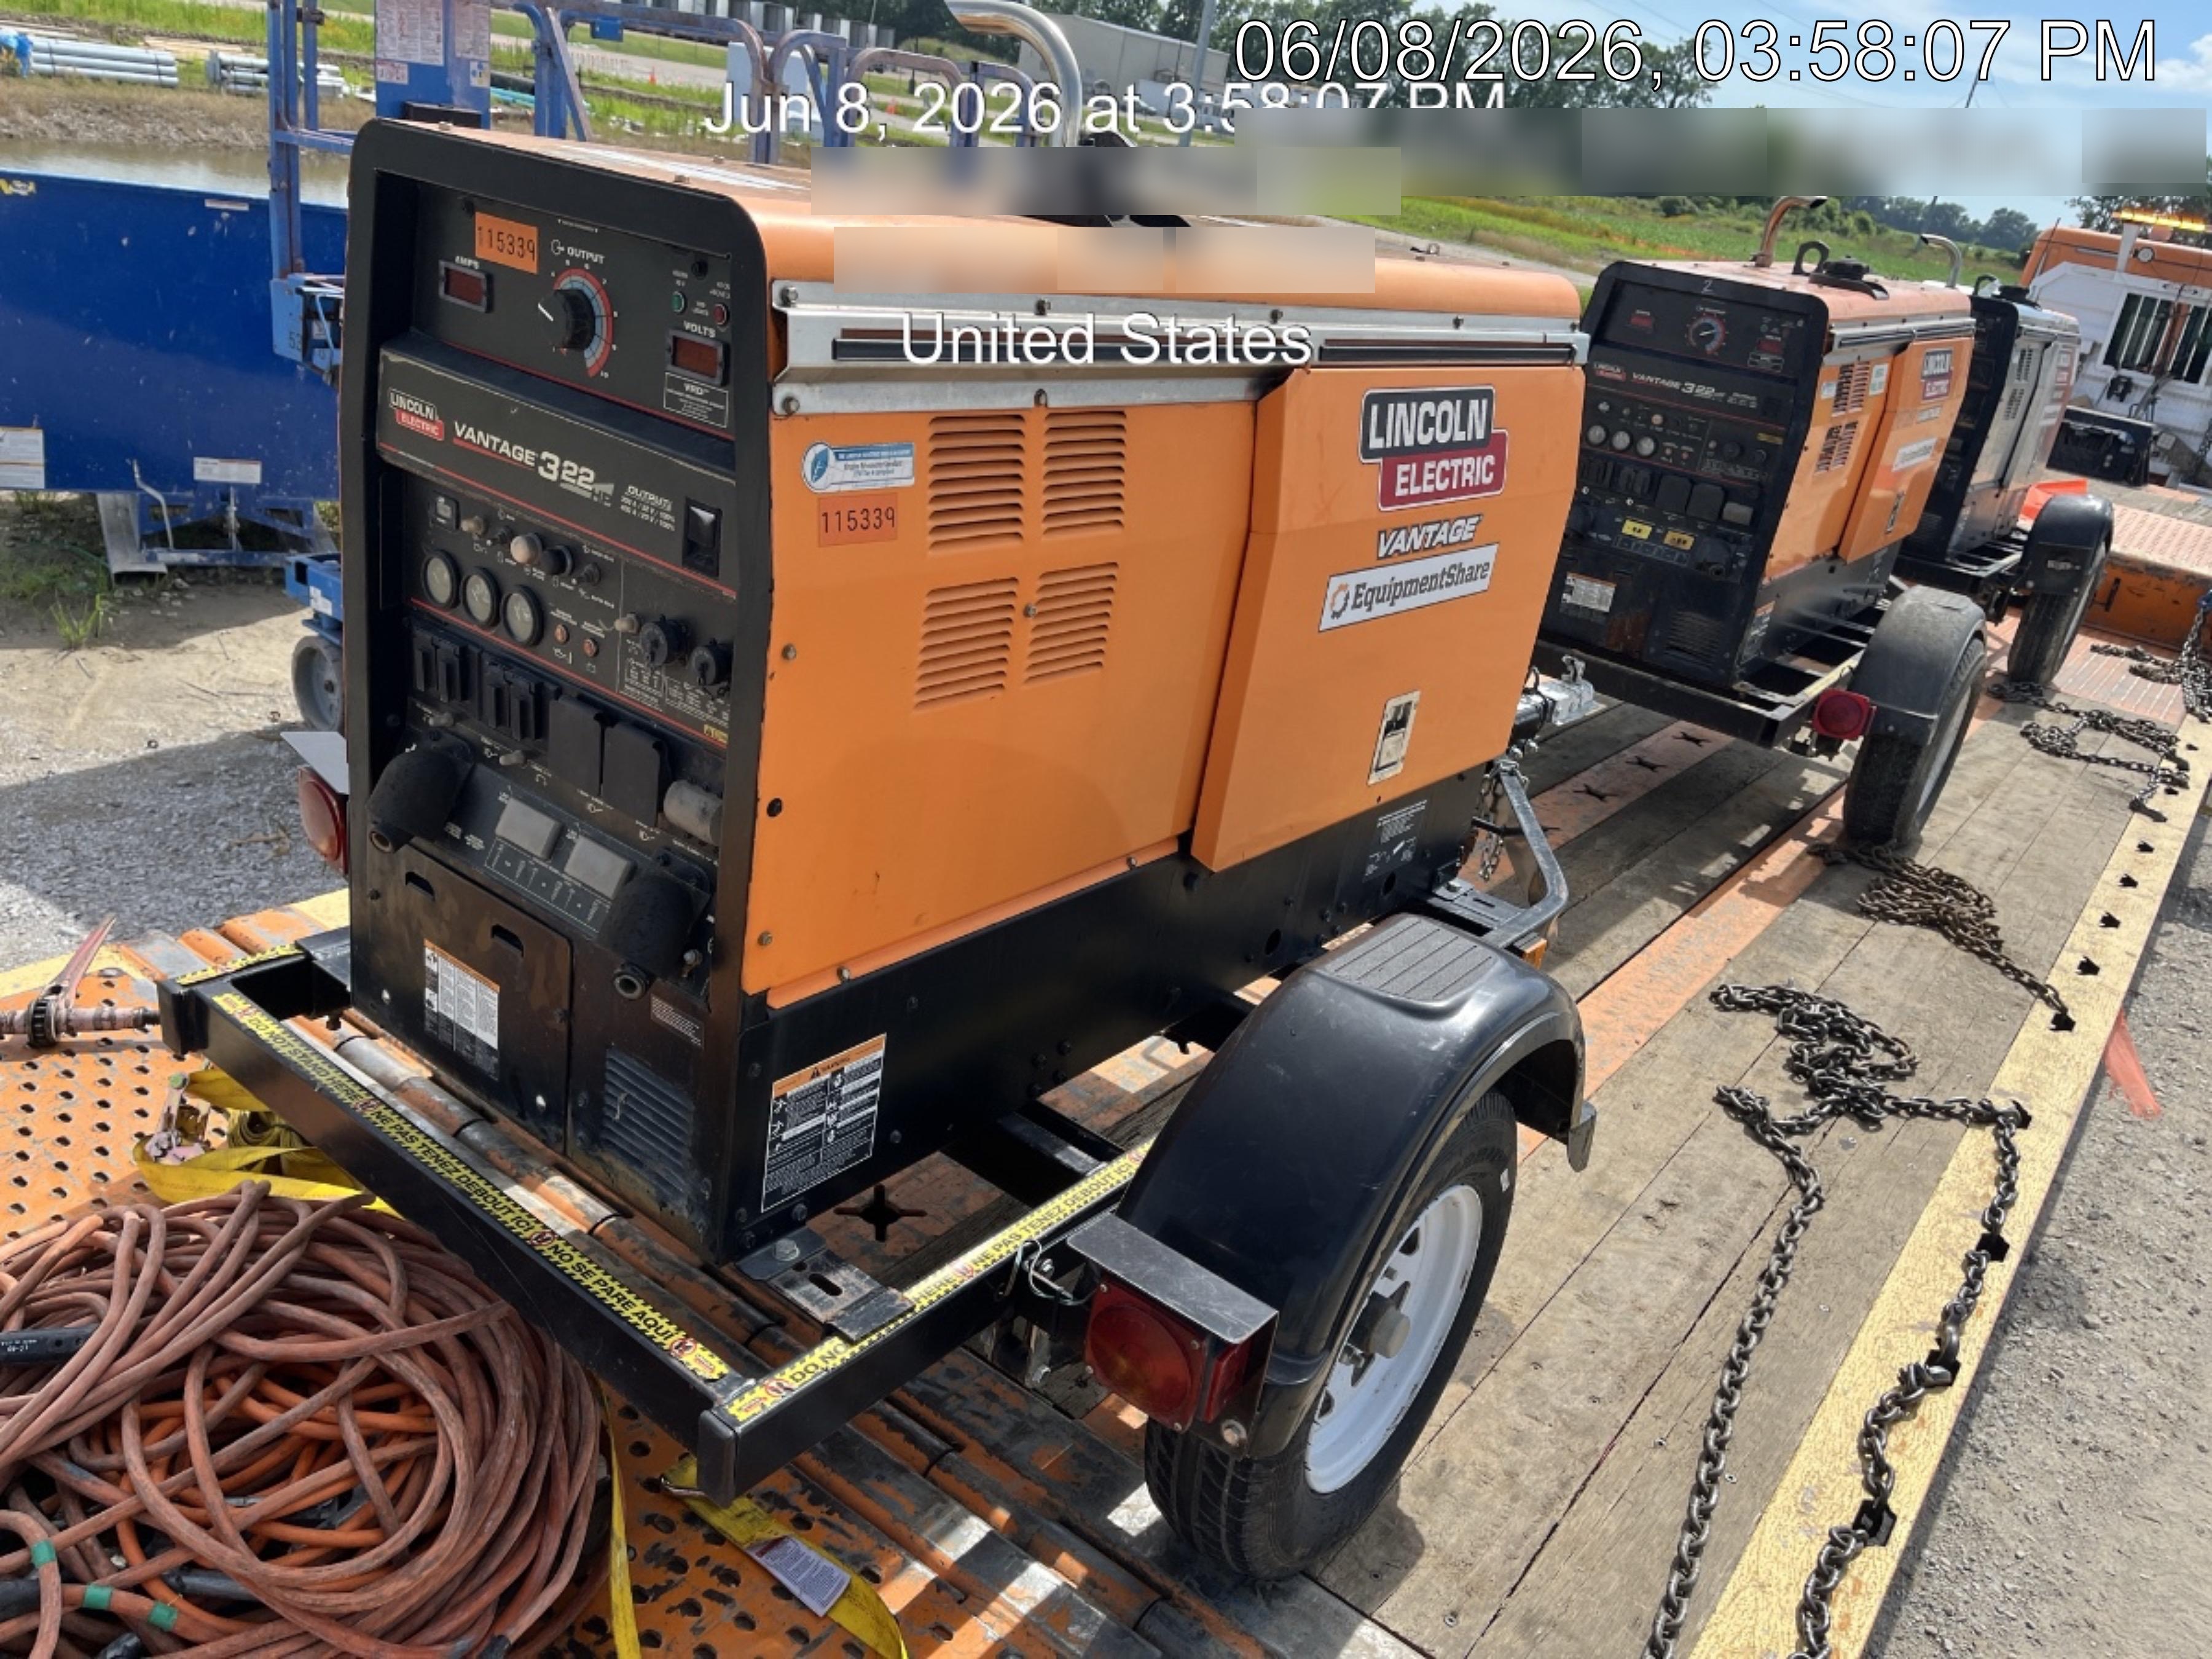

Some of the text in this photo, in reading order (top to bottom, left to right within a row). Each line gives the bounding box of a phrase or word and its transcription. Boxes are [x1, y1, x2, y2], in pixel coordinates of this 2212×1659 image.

[477, 226, 536, 262] 115339
[567, 246, 605, 265] OUTPUT
[683, 320, 716, 337] VOLTS
[390, 391, 435, 420] LINCOLN
[1368, 398, 1488, 449] LINCOLN
[453, 420, 595, 491] VANTAGE 322
[1395, 455, 1496, 496] ELECTRIC
[822, 506, 895, 533] 115339
[1377, 514, 1484, 561] VANTAGE
[1352, 560, 1490, 613] EquipmentShare
[373, 1111, 394, 1124] NE
[393, 1125, 419, 1143] PAS
[419, 1142, 462, 1174] TENEZ
[455, 1175, 515, 1218] DEBOUT
[991, 1232, 1022, 1253] PAS
[1023, 1206, 1064, 1234] TENEZ
[1062, 1174, 1116, 1206] DEBOUT
[547, 1243, 677, 1341] NO SE PARE AQUI
[789, 1361, 819, 1383] DO
